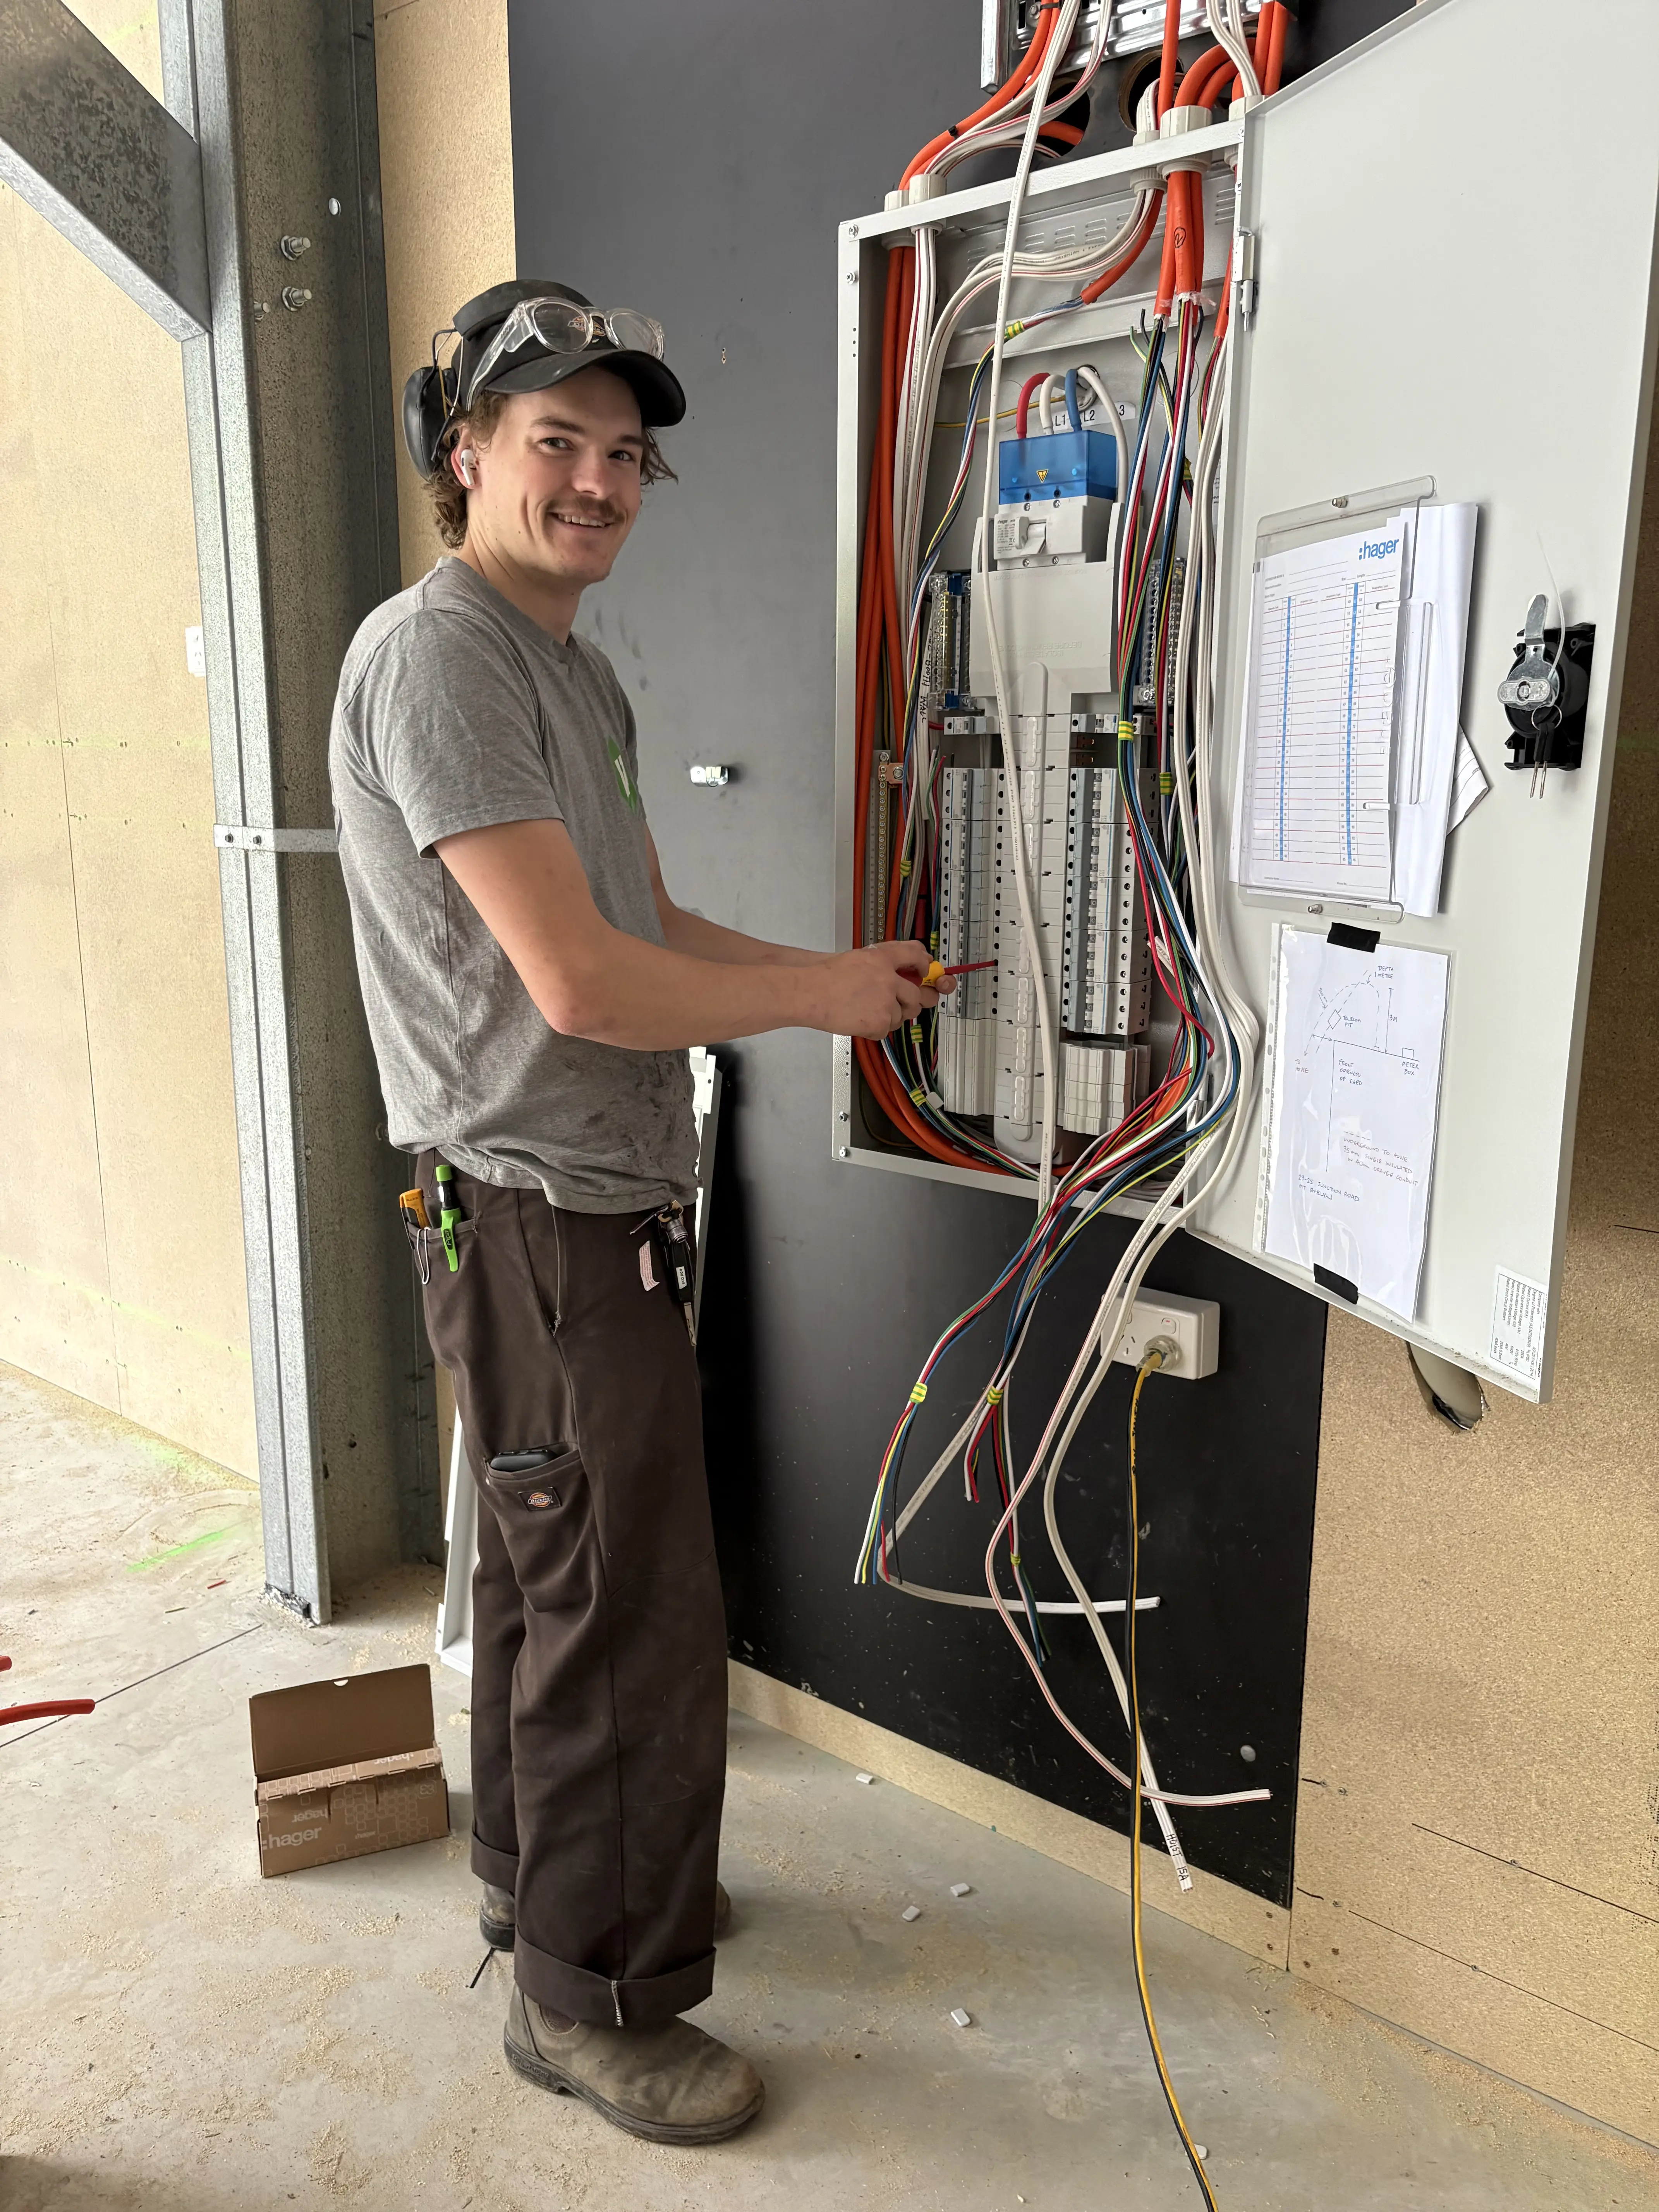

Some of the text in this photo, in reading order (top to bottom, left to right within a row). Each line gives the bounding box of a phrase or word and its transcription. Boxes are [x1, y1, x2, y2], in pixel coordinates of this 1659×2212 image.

[1055, 414, 1065, 426] L1
[1340, 1068, 1361, 1077] CORNER
[1365, 1154, 1382, 1164] SINGLE
[1385, 1161, 1412, 1174] INSULATED
[1393, 1153, 1408, 1163] HOUSE
[1373, 1166, 1394, 1178] ORANGE
[1396, 1175, 1418, 1186] CONDUIT
[1298, 1174, 1359, 1201] 23-25 JUNCTION ROAD
[1310, 1188, 1332, 1200] EVELYN
[1166, 1833, 1183, 1857] HOIST
